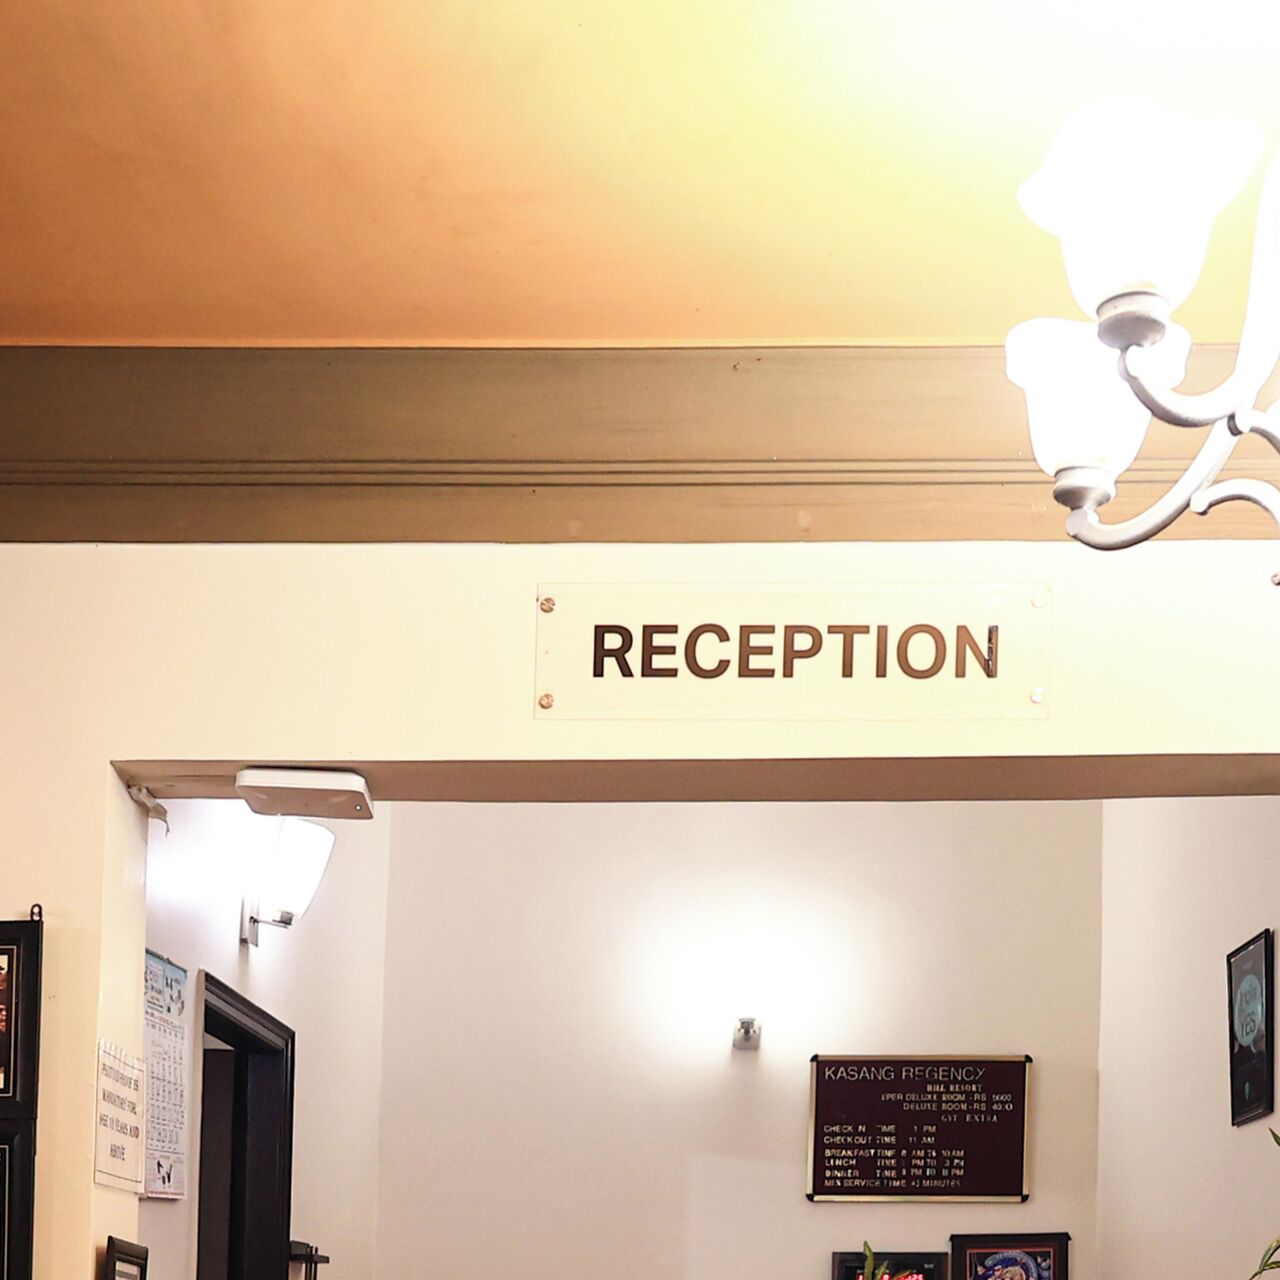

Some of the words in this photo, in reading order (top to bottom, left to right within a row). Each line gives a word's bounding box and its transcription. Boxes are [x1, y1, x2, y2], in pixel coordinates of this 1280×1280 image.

[593, 623, 999, 679] RECEPTION
[825, 1066, 895, 1081] KASANG
[902, 1066, 986, 1081] REGENCY
[949, 1084, 983, 1092] RESORT
[905, 1093, 938, 1101] DELUXE
[942, 1093, 966, 1101] ROOM
[974, 1093, 987, 1101] RS
[903, 1103, 938, 1111] DELUXE
[941, 1103, 967, 1111] ROOM
[974, 1103, 986, 1111] RS
[876, 1136, 896, 1144] TIME
[824, 1149, 876, 1157] BREAKFAST
[825, 1170, 859, 1178] DINNER
